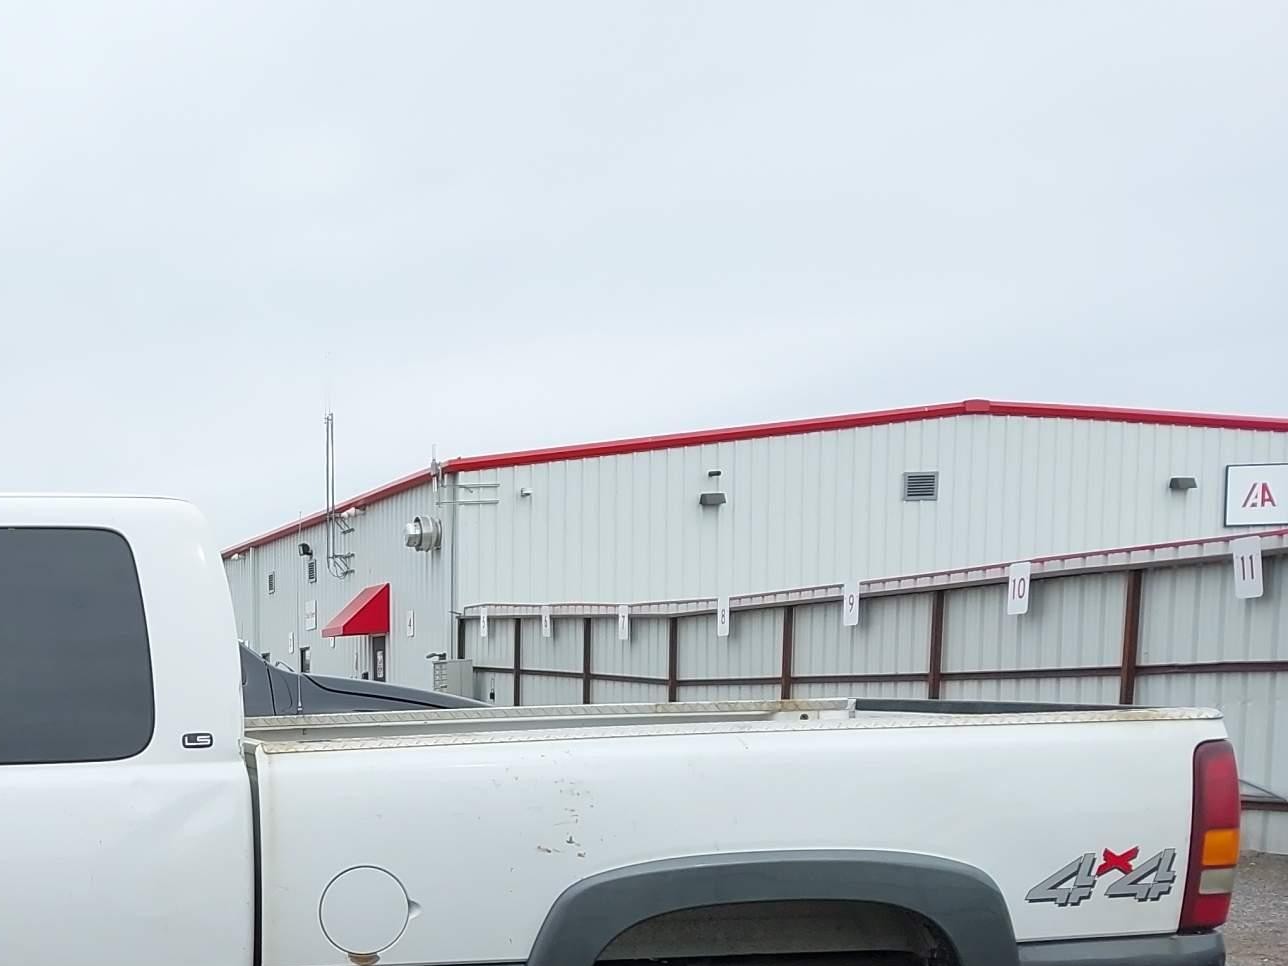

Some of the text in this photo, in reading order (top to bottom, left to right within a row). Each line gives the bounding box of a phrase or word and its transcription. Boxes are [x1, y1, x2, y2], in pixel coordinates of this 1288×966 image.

[1240, 555, 1255, 581] 11
[1012, 577, 1026, 600] 10
[848, 594, 855, 614] 9
[720, 608, 727, 625] 8
[184, 735, 211, 746] LS
